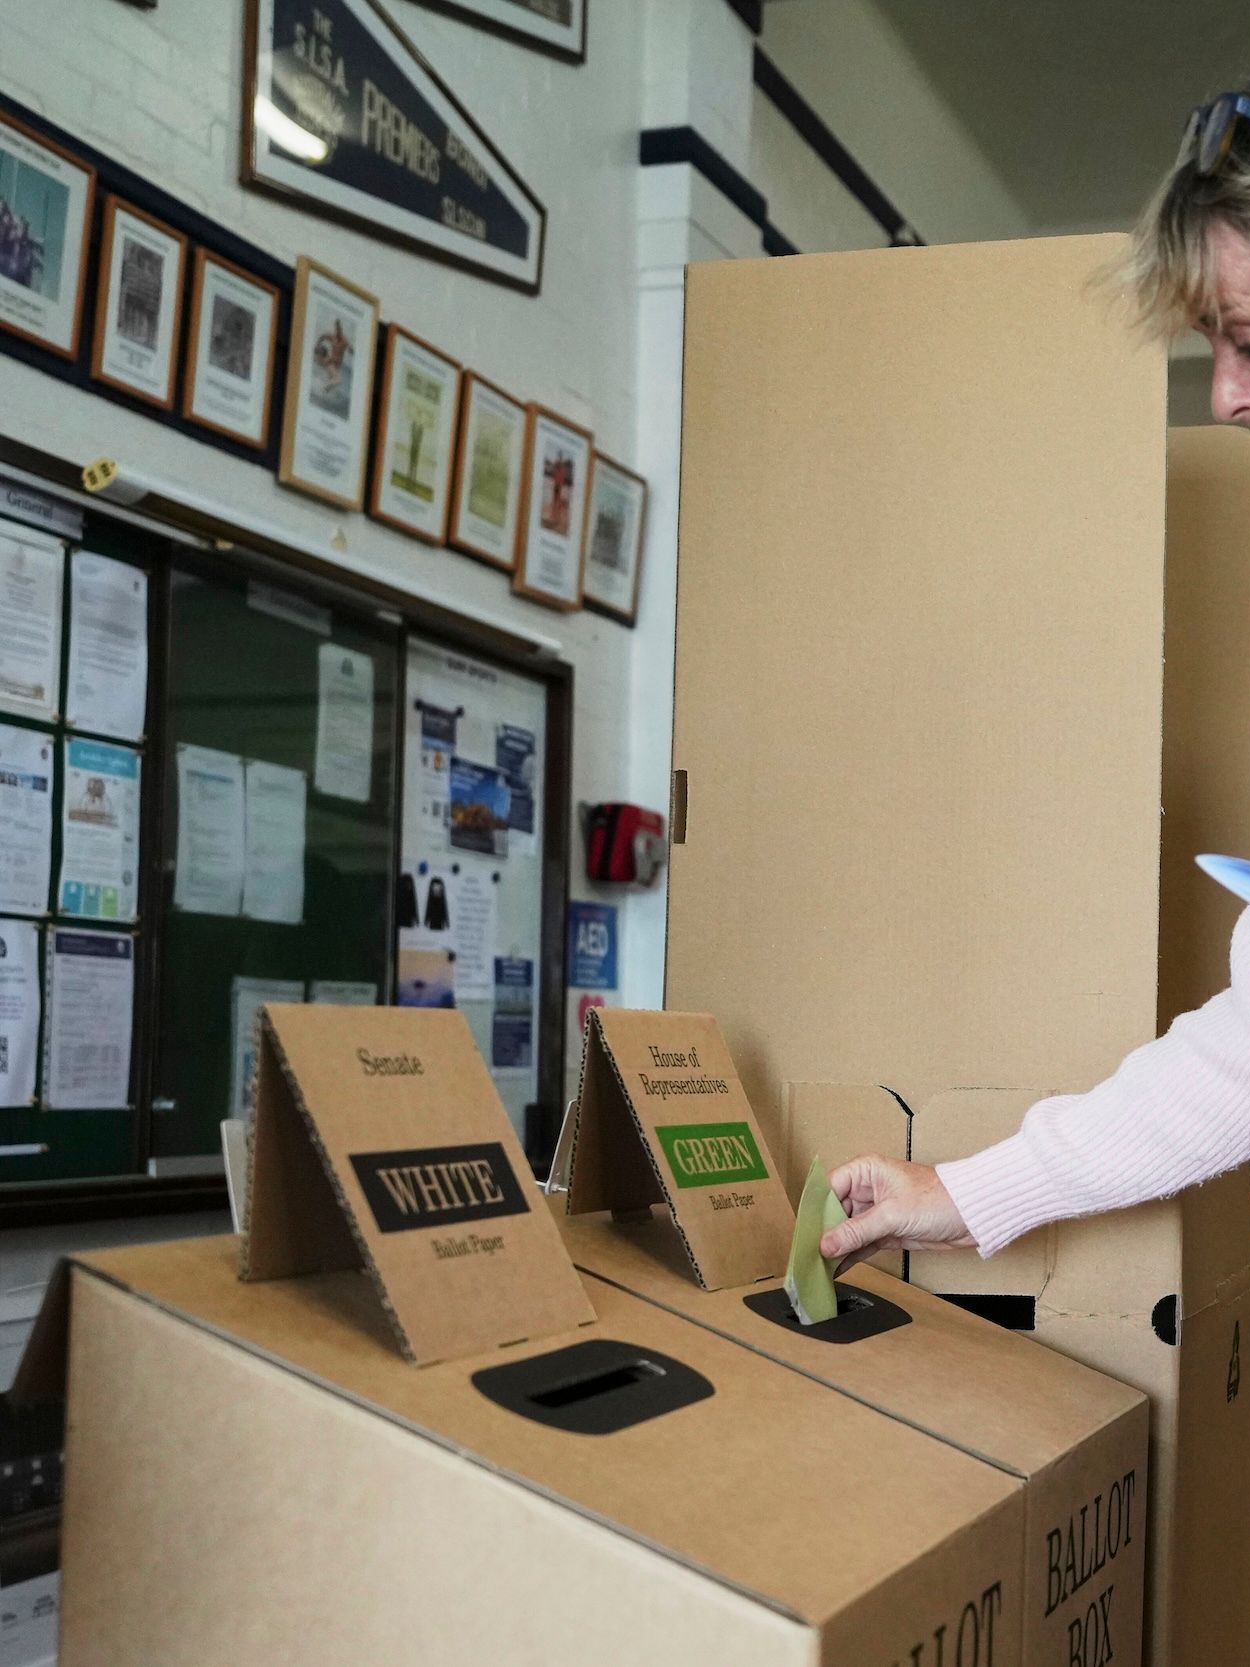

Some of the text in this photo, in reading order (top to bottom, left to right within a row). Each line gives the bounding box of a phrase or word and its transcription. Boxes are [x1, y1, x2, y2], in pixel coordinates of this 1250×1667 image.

[361, 78, 440, 185] PREMIERS
[577, 922, 609, 957] AED
[357, 1047, 425, 1076] Senate
[648, 1045, 701, 1068] House of
[638, 1073, 729, 1100] Representatives
[673, 1136, 755, 1176] GREEN
[376, 1159, 505, 1216] WHITE
[709, 1192, 755, 1210] Ballot Paper
[431, 1234, 505, 1259] Ballot Paper
[1044, 1469, 1135, 1618] BALLOT
[1068, 1584, 1114, 1667] BOX
